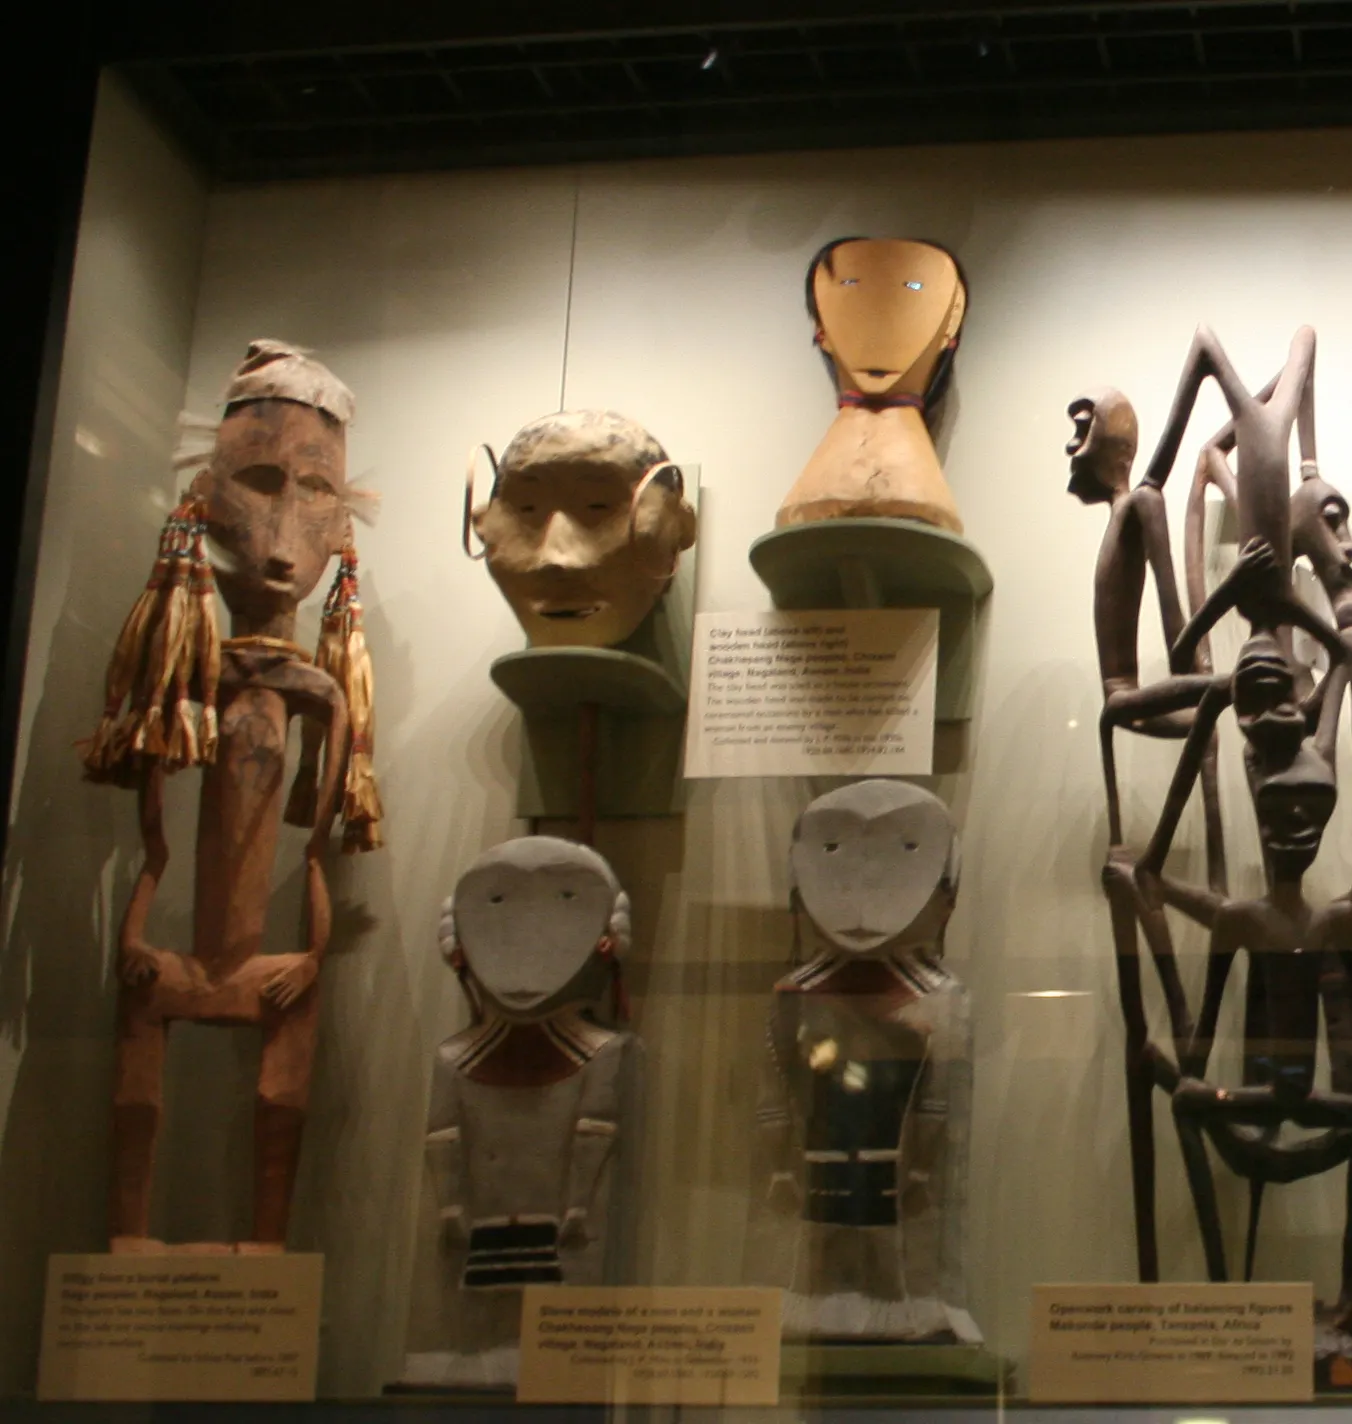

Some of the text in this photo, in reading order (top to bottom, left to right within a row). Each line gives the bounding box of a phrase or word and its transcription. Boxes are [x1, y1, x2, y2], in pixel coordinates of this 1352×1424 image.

[709, 628, 732, 639] Clay
[735, 627, 761, 637] head
[753, 640, 778, 650] head
[1168, 1302, 1181, 1314] of
[1223, 1319, 1260, 1330] Africa
